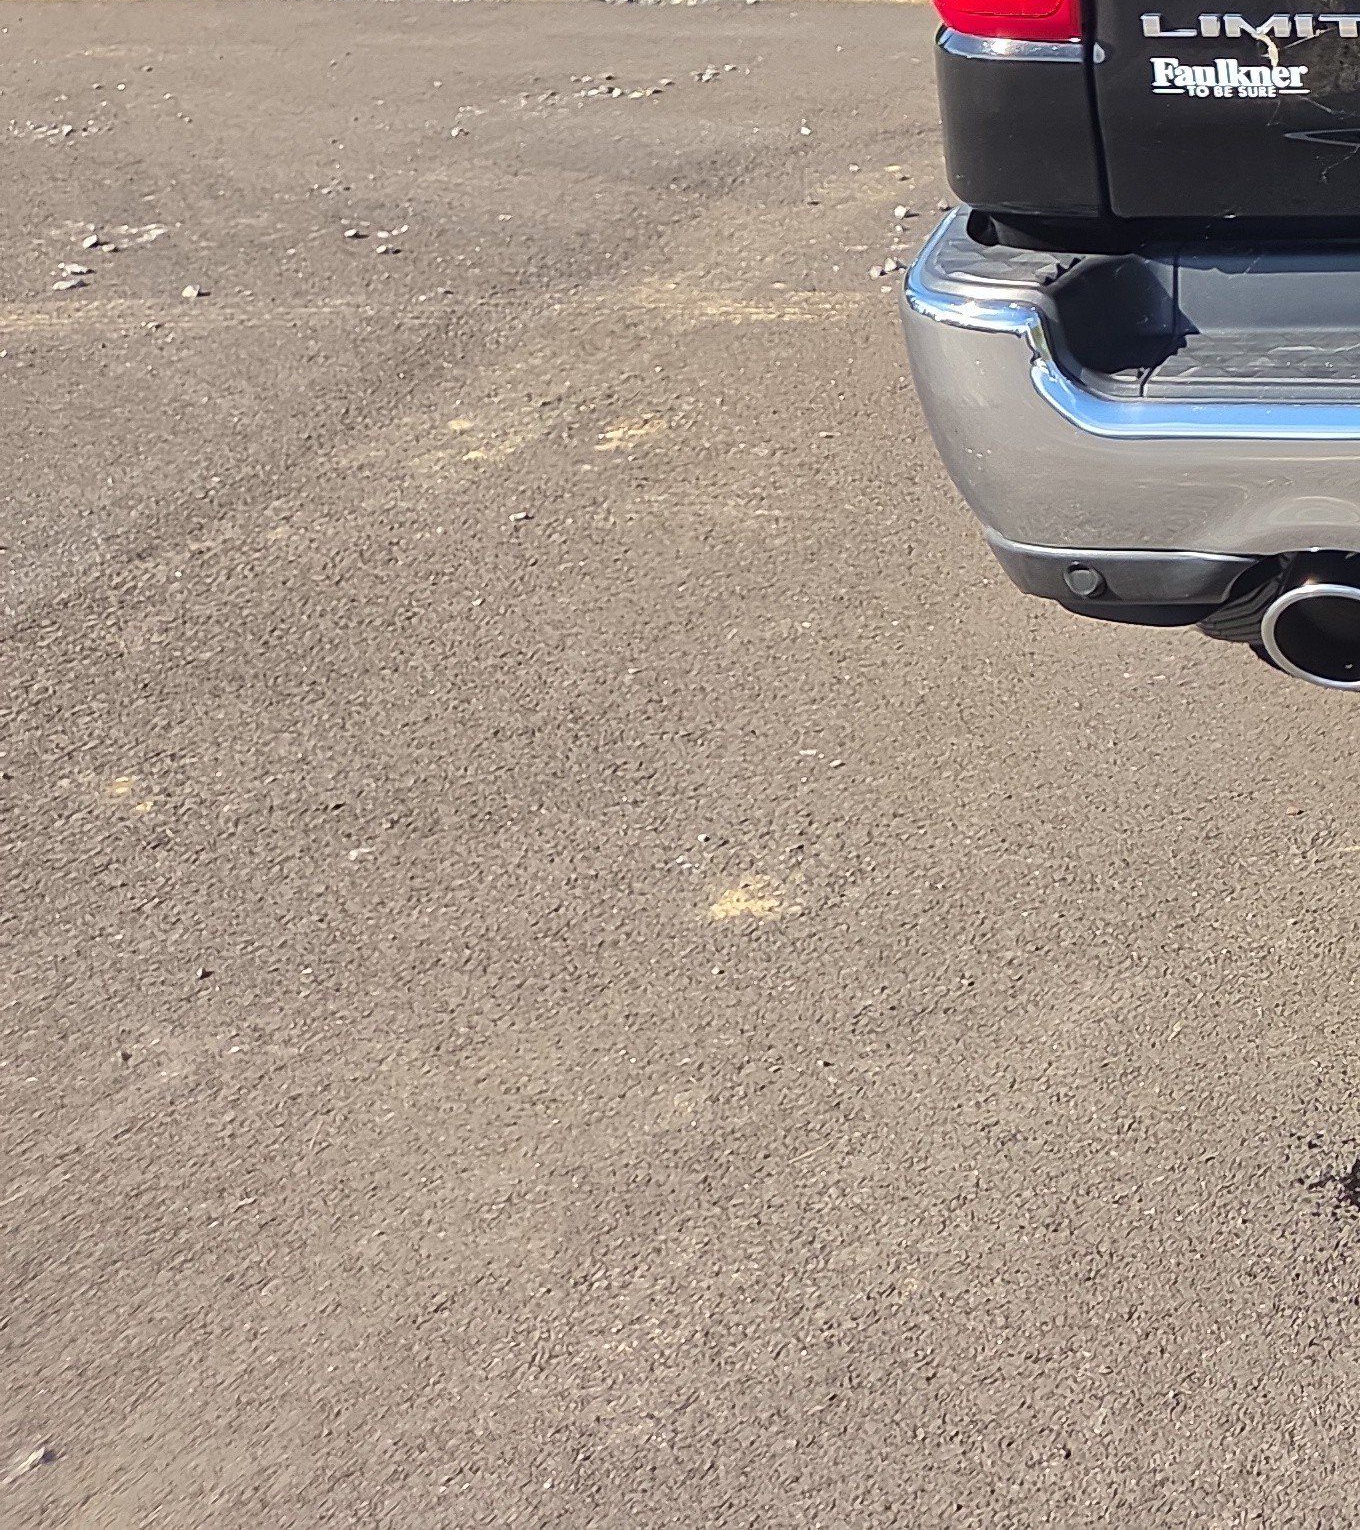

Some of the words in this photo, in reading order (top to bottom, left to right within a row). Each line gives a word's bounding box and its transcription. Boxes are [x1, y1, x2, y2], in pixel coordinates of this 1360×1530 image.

[1150, 57, 1309, 88] Faulkner
[1187, 86, 1210, 98] TO
[1213, 86, 1234, 98] BE
[1238, 86, 1277, 98] SURE
